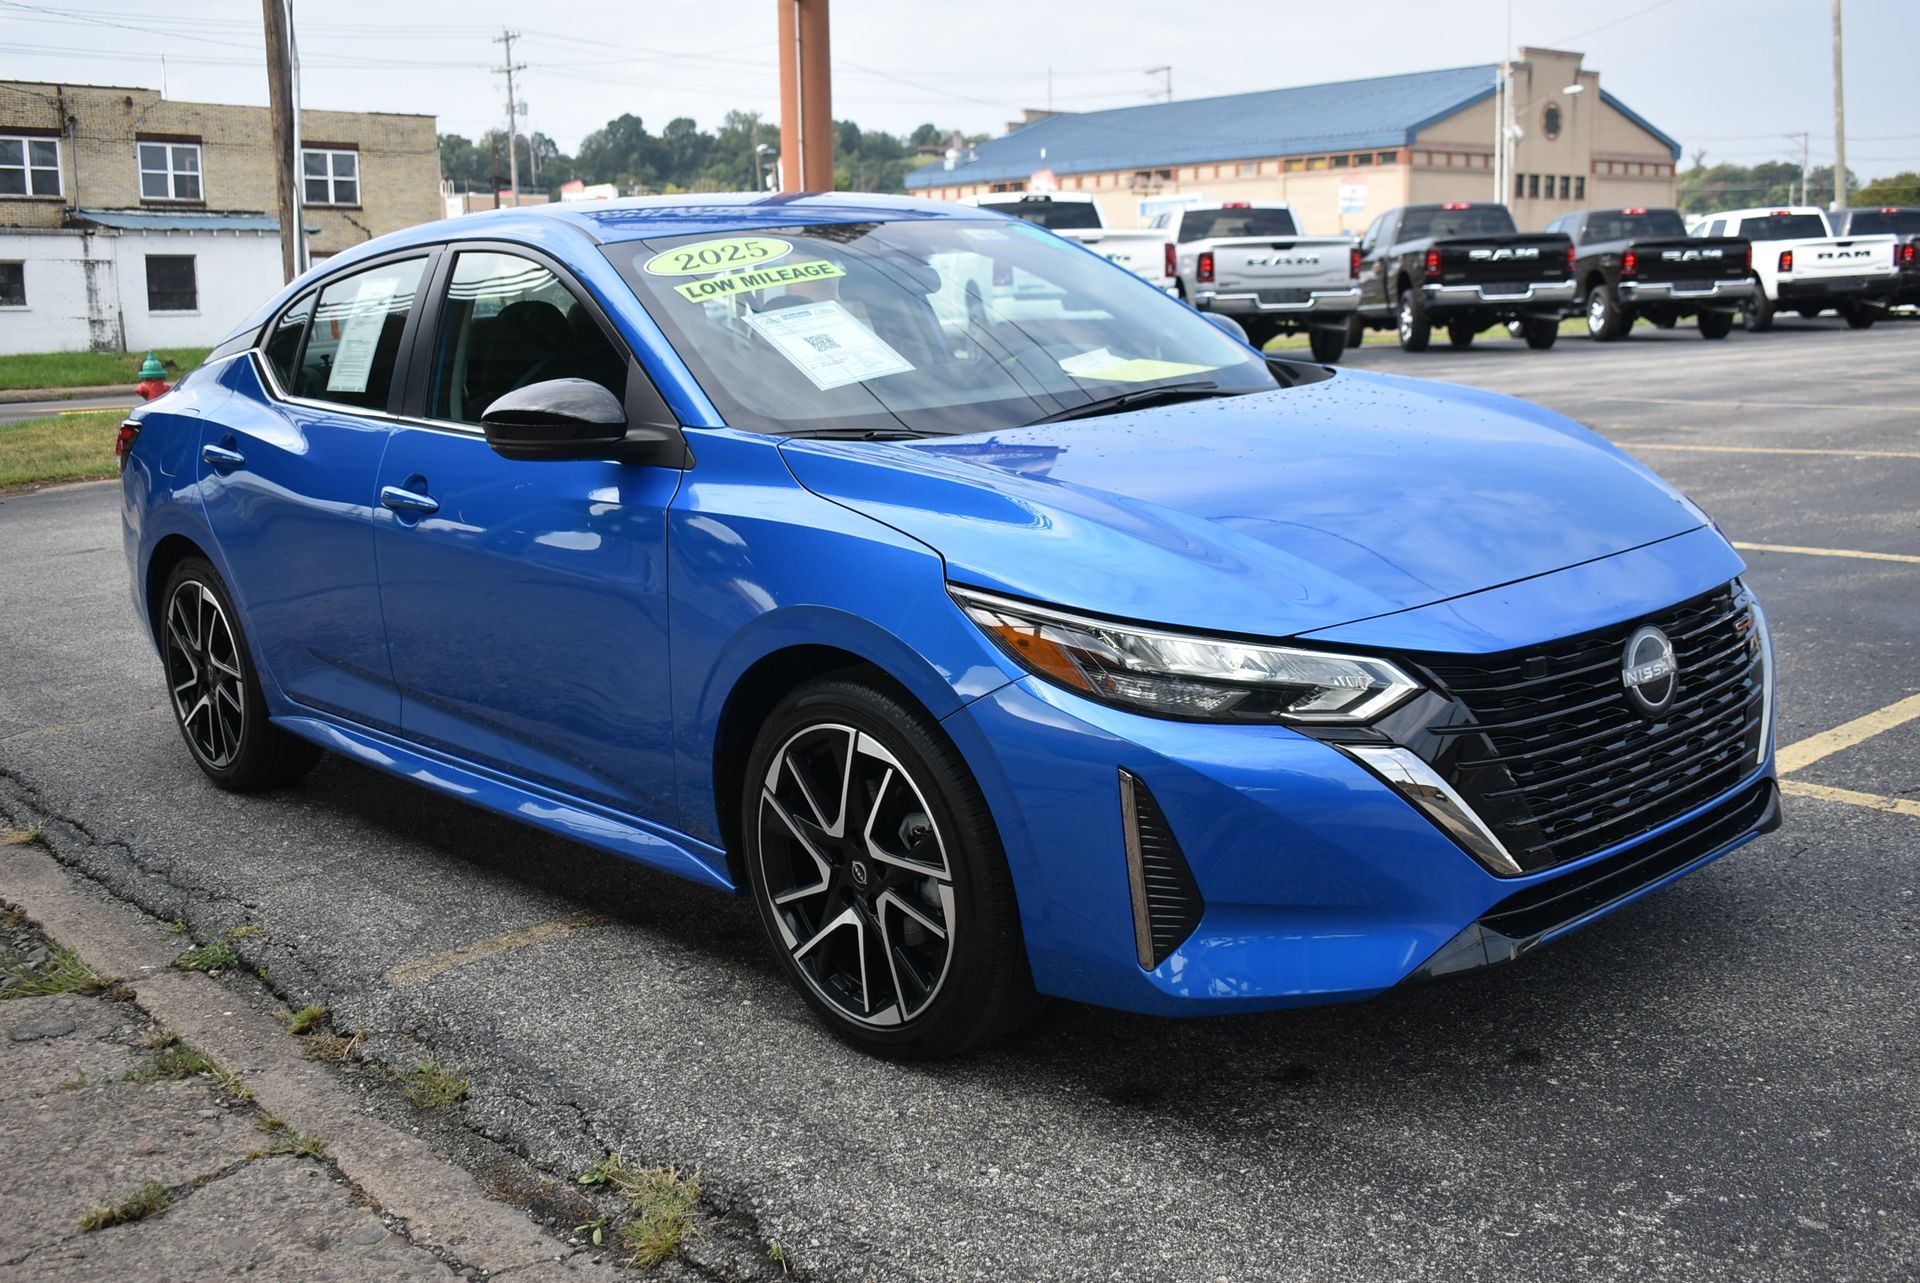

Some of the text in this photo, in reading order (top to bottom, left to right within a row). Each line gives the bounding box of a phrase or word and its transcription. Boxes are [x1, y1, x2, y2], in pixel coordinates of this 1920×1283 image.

[674, 241, 768, 271] 2025
[1468, 247, 1540, 262] RAM
[1661, 248, 1723, 262] RAM
[1817, 250, 1871, 260] RAM
[685, 264, 833, 299] LOW MILEAGE
[1626, 656, 1676, 684] NISSAN
